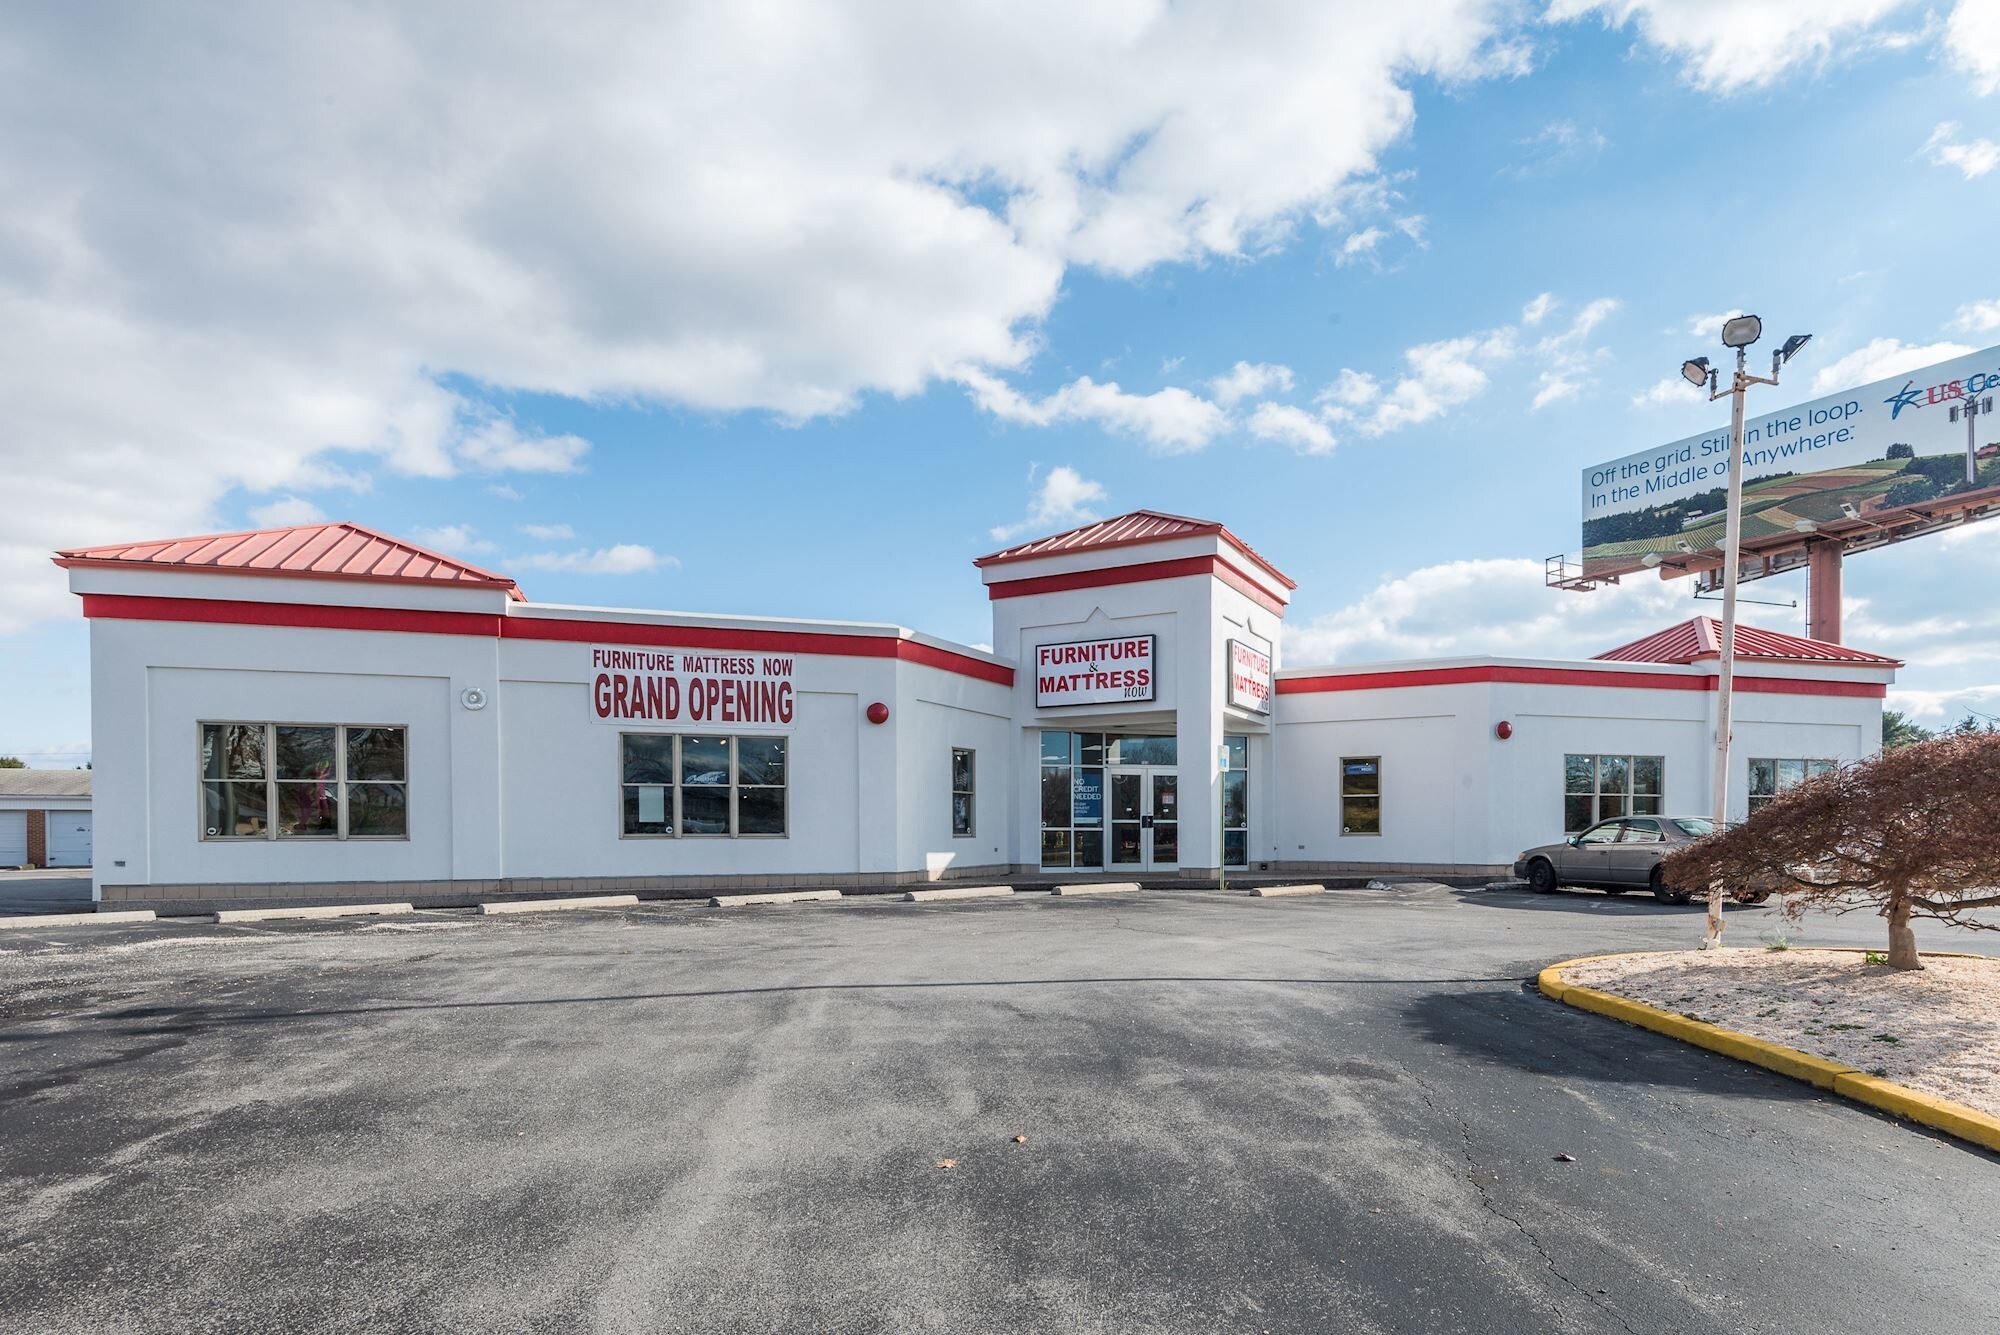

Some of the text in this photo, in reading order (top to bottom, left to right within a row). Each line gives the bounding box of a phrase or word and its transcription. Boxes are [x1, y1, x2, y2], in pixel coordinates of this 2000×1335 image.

[1591, 400, 1863, 487] Off the grid. Stil in the loop.
[1592, 494, 1606, 508] In
[1611, 485, 1639, 503] the
[1645, 466, 1708, 494] Middle
[593, 649, 793, 676] FURNITURE MATTRESS NOW
[1040, 640, 1149, 665] FURNITURE
[1088, 662, 1098, 672] &
[1234, 644, 1269, 675] FURNITURE
[1039, 669, 1150, 693] MATTRESS
[1233, 672, 1269, 701] MATTRESS
[594, 673, 793, 724] GRAND OPENING
